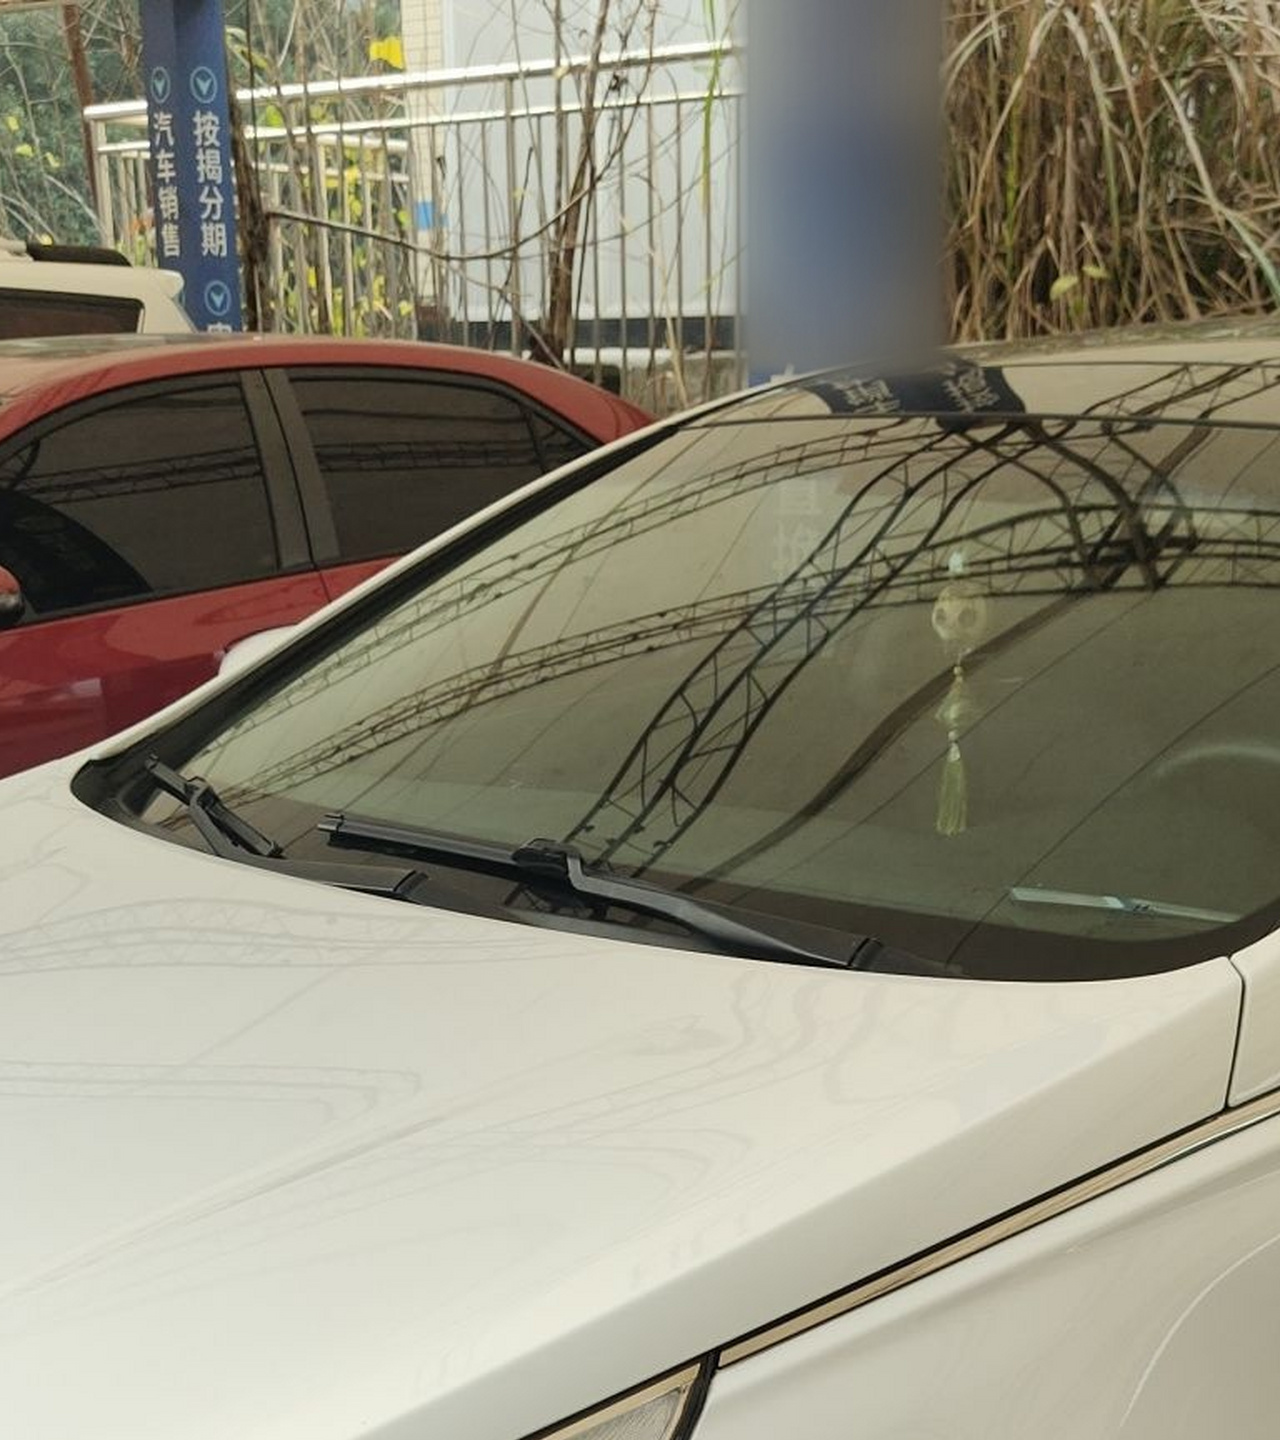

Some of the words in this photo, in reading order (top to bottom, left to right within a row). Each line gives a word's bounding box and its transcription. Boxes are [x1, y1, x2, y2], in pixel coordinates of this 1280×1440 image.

[153, 112, 181, 257] 汽车销售
[193, 110, 228, 257] 按揭分期
